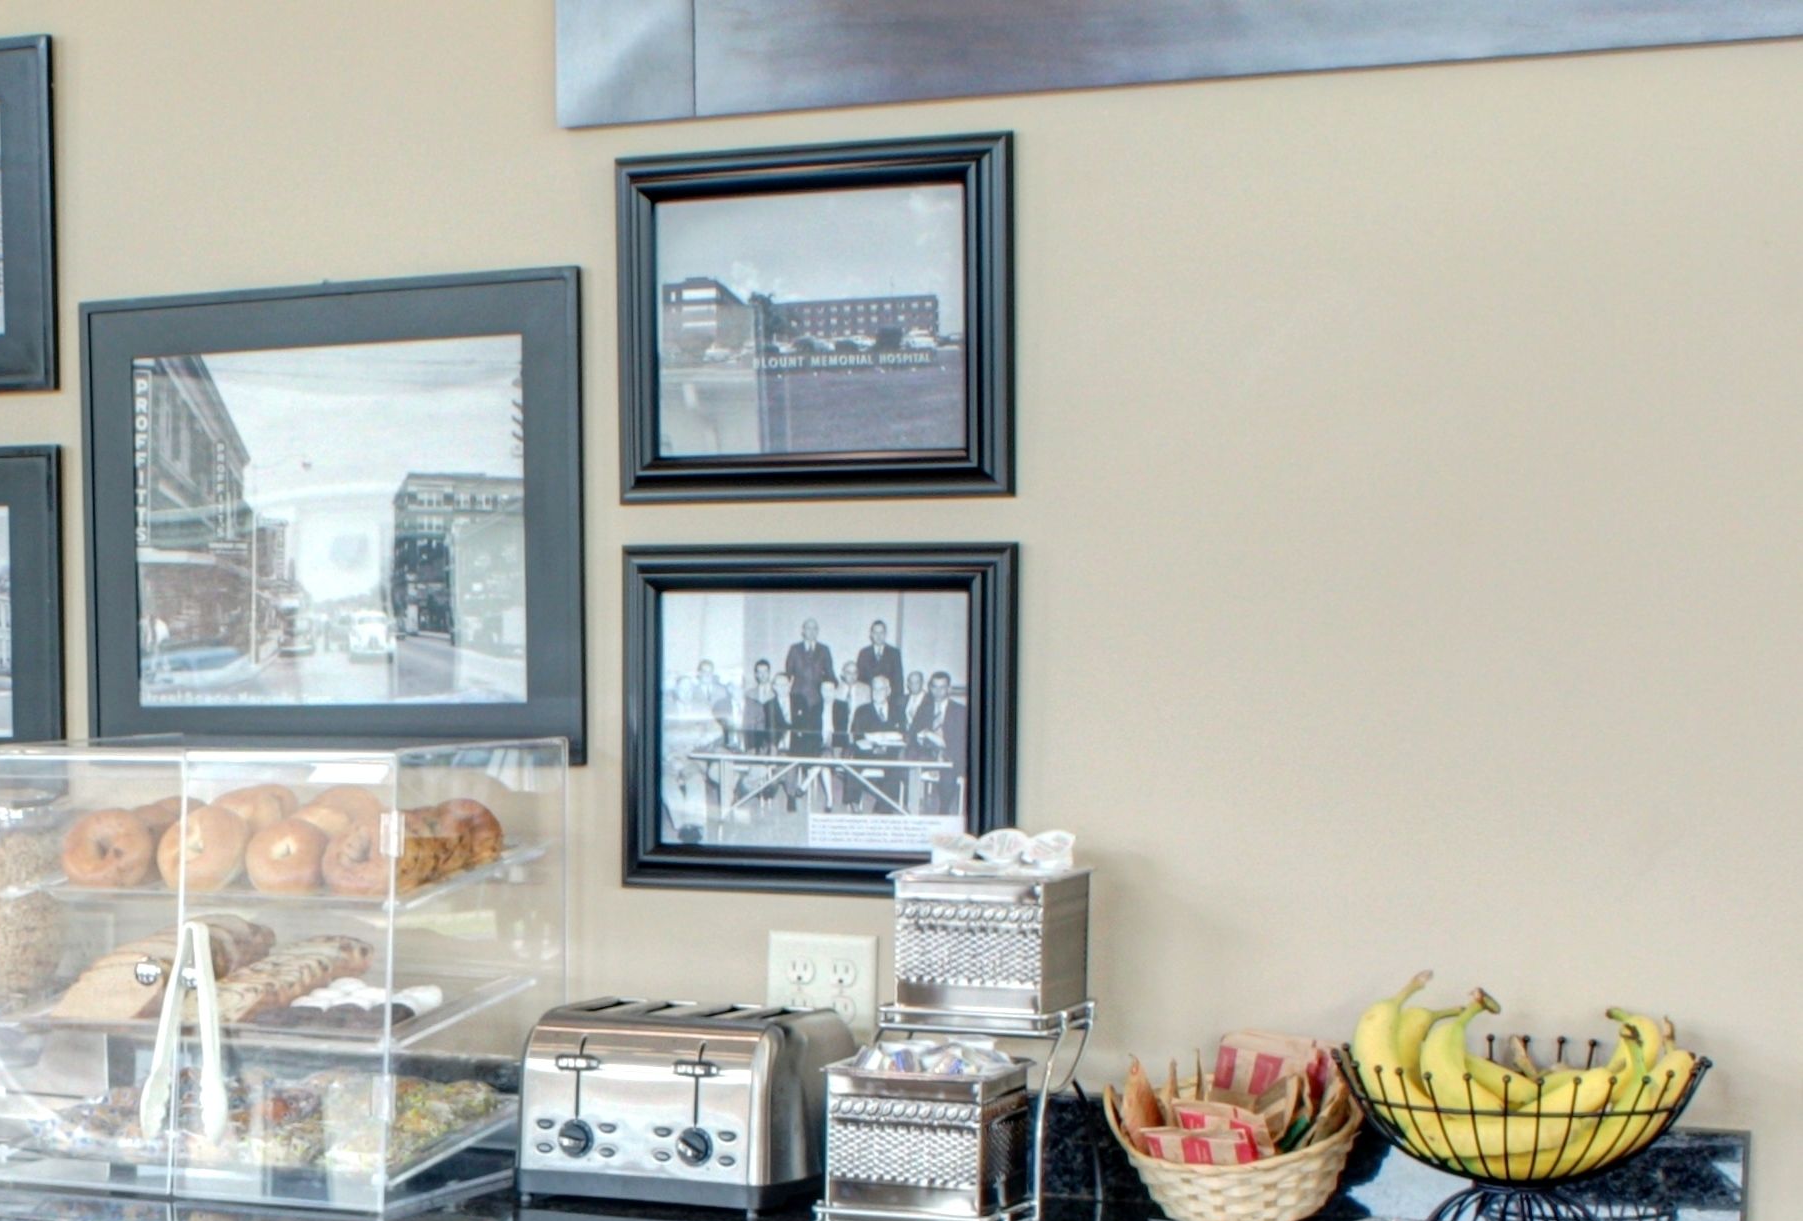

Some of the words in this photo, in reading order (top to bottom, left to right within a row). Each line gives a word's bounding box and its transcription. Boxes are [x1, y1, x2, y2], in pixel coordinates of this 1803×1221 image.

[753, 356, 805, 370] BLOUNT
[810, 354, 874, 368] MEMORIAL
[878, 352, 932, 365] HOSPITAL
